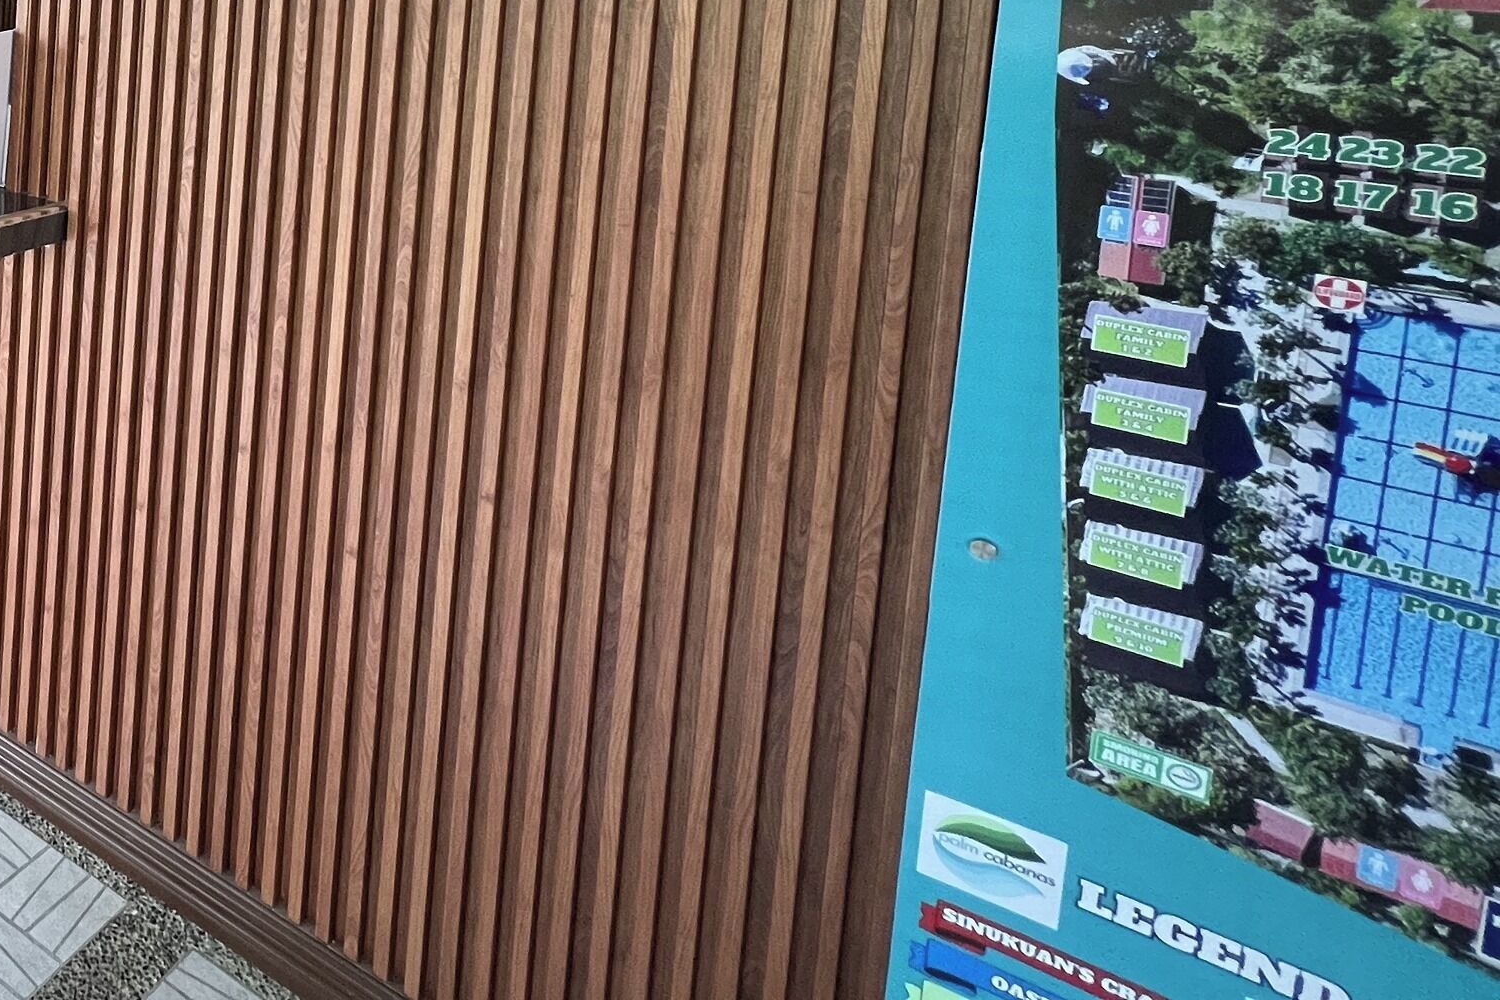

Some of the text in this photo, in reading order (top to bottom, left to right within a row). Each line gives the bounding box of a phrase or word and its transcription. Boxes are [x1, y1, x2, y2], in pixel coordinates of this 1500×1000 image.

[1263, 128, 1488, 179] 24 23 22
[1262, 170, 1478, 223] 18 17 16
[1096, 320, 1189, 342] DUPLEX CABIN
[1116, 332, 1165, 348] FAMILY
[1096, 394, 1189, 419] DUPLEX CABIN
[1116, 407, 1165, 424] FAMILY
[1094, 464, 1186, 492] DUPLEX CABIN
[1100, 475, 1178, 500] WITH ATTIC
[1092, 534, 1183, 563] DUPLEX CABIN
[1098, 545, 1175, 573] WITH ATTIC
[1325, 543, 1473, 600] WATER
[1093, 609, 1184, 642] DUPLEX CABIN
[1105, 621, 1168, 647] PREMIUM
[1100, 749, 1157, 780] AREA
[938, 832, 1057, 888] palm cabanas
[941, 906, 1096, 985] SINUKUAN'S
[1077, 876, 1353, 1000] LEGEND
